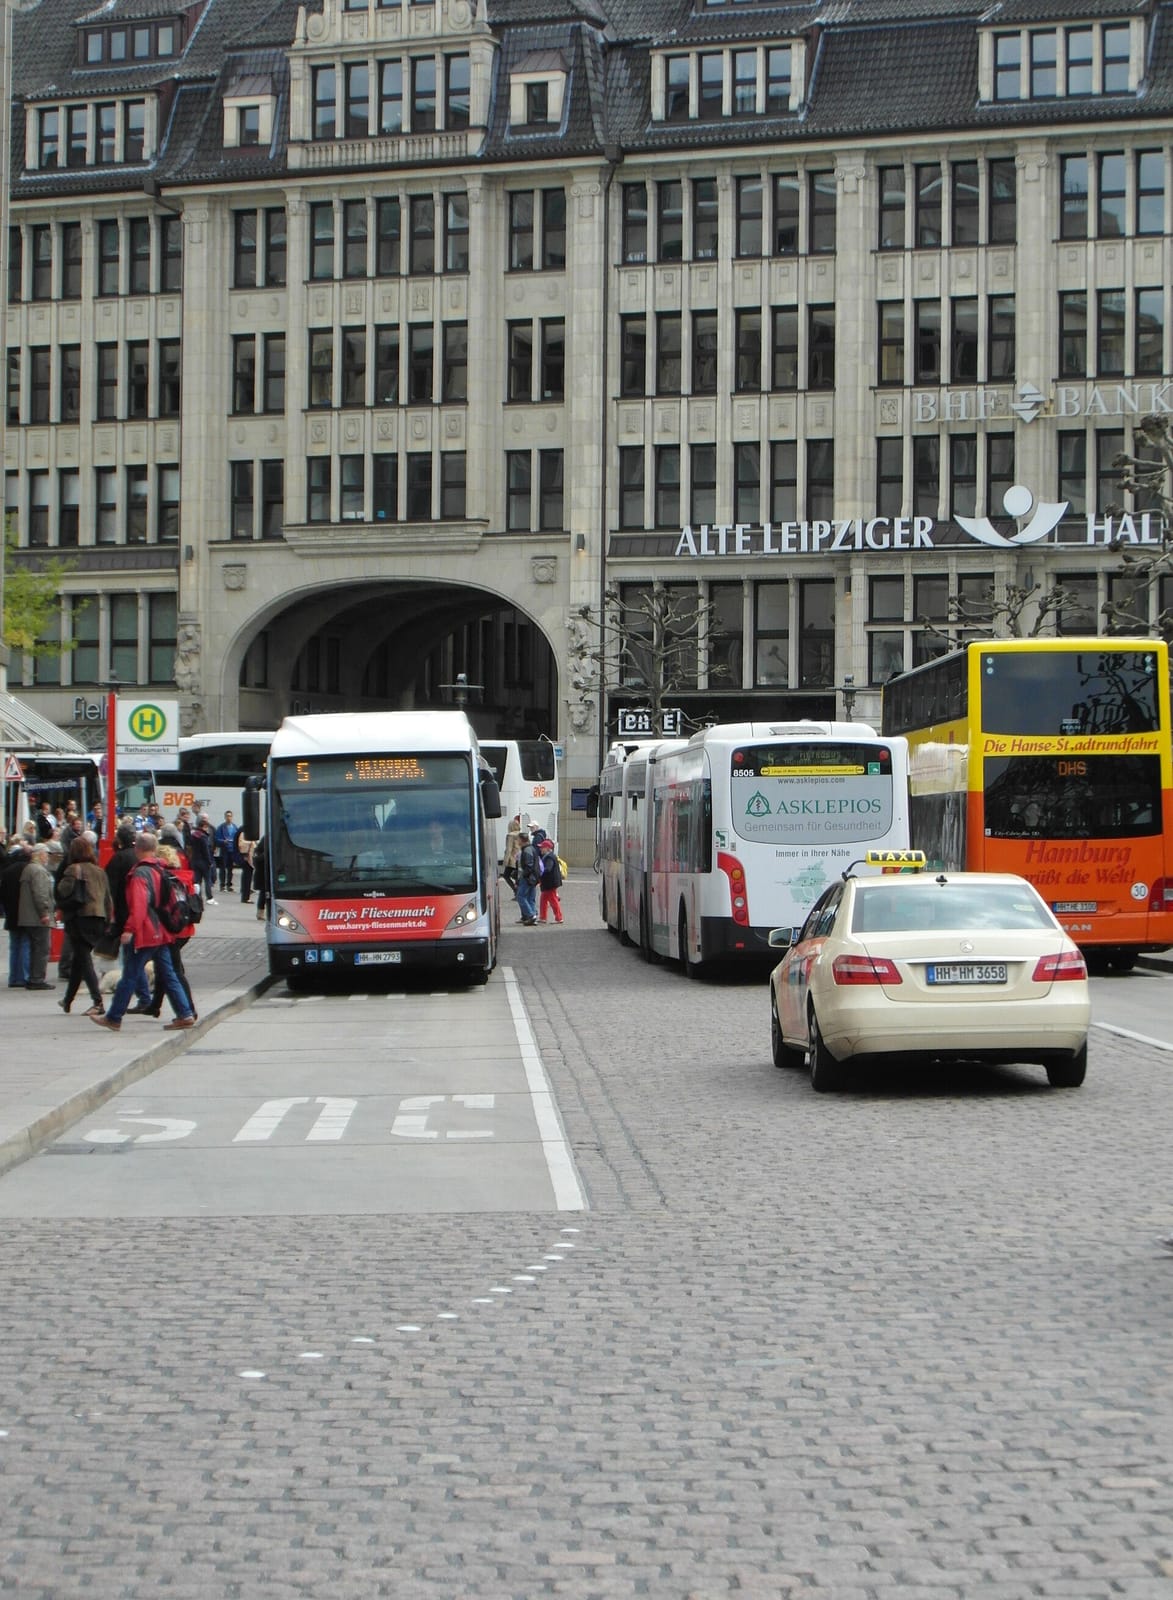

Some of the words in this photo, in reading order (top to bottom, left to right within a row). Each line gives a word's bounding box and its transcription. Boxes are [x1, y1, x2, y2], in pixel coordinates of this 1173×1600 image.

[914, 389, 998, 423] BHF
[1057, 383, 1173, 417] BANK
[674, 523, 750, 556] ALTE
[763, 515, 935, 554] LEIPZIGER
[1086, 512, 1165, 545] HAL
[73, 695, 109, 720] fiel
[138, 712, 156, 734] H
[624, 713, 674, 730] BAE
[984, 738, 1006, 753] Die
[733, 769, 754, 777] 8505
[1058, 761, 1087, 776] DHS
[777, 777, 845, 785] www.asklepios.com
[163, 792, 195, 807] BVB
[776, 798, 881, 815] ASKLEPIOS
[744, 821, 804, 833] Gemeinsam
[807, 820, 821, 832] für
[824, 819, 881, 832] Gesundheit
[775, 850, 799, 858] Immer
[801, 849, 809, 858] in
[810, 849, 829, 858] Ihrer
[831, 848, 850, 857] Nähe
[876, 851, 916, 861] TAXI
[1025, 840, 1132, 867] Hamburg
[1066, 868, 1090, 885] die
[1095, 867, 1136, 883] Welt!
[1134, 885, 1147, 898] 30
[360, 905, 435, 919] Fliesenmarkt
[326, 919, 427, 932] www.harrys-fliesenmarkt.de
[935, 966, 951, 980] HH
[960, 966, 974, 979] HM
[976, 966, 1006, 979] 3658
